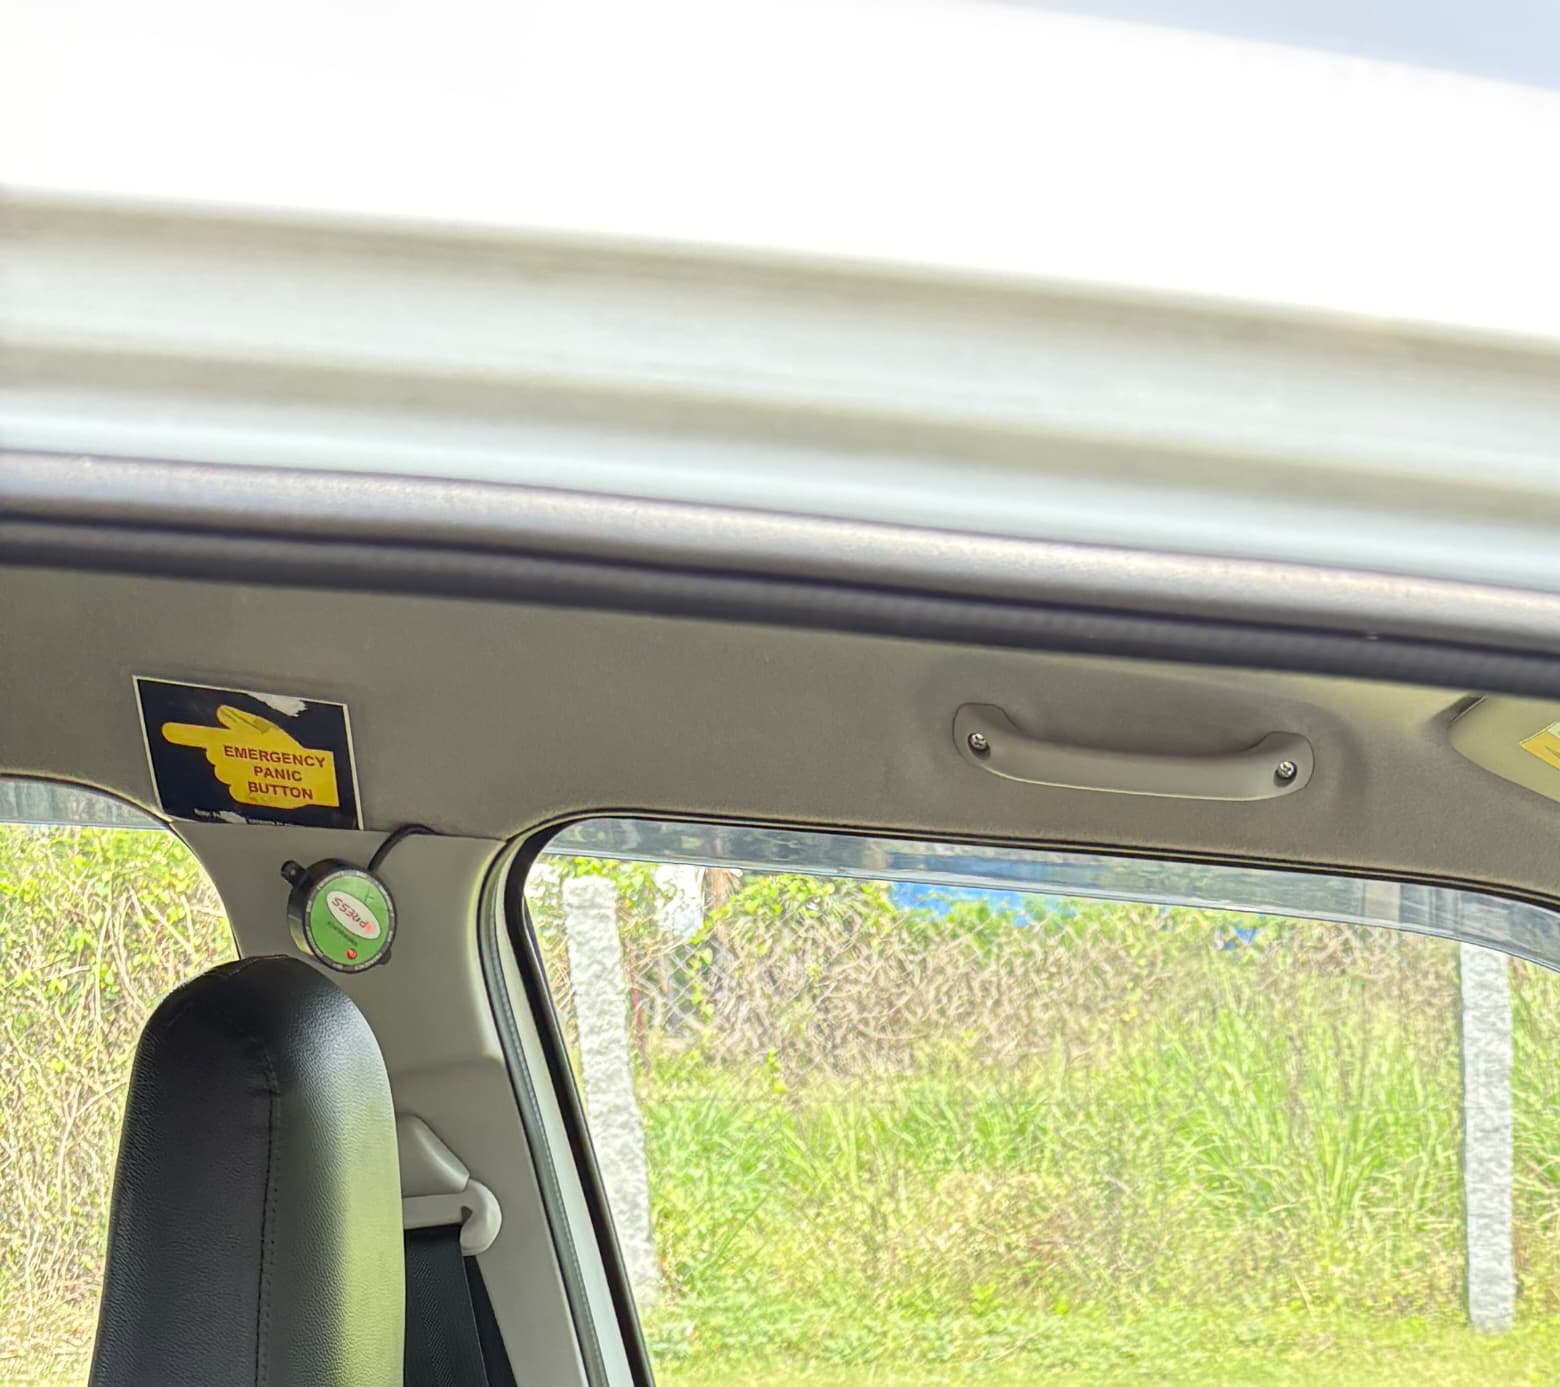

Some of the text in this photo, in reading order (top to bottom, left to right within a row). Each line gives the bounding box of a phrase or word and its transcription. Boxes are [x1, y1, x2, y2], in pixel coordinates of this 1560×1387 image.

[223, 744, 326, 769] EMERGENCY
[253, 765, 303, 782] PANIC
[248, 781, 314, 800] BUTTON
